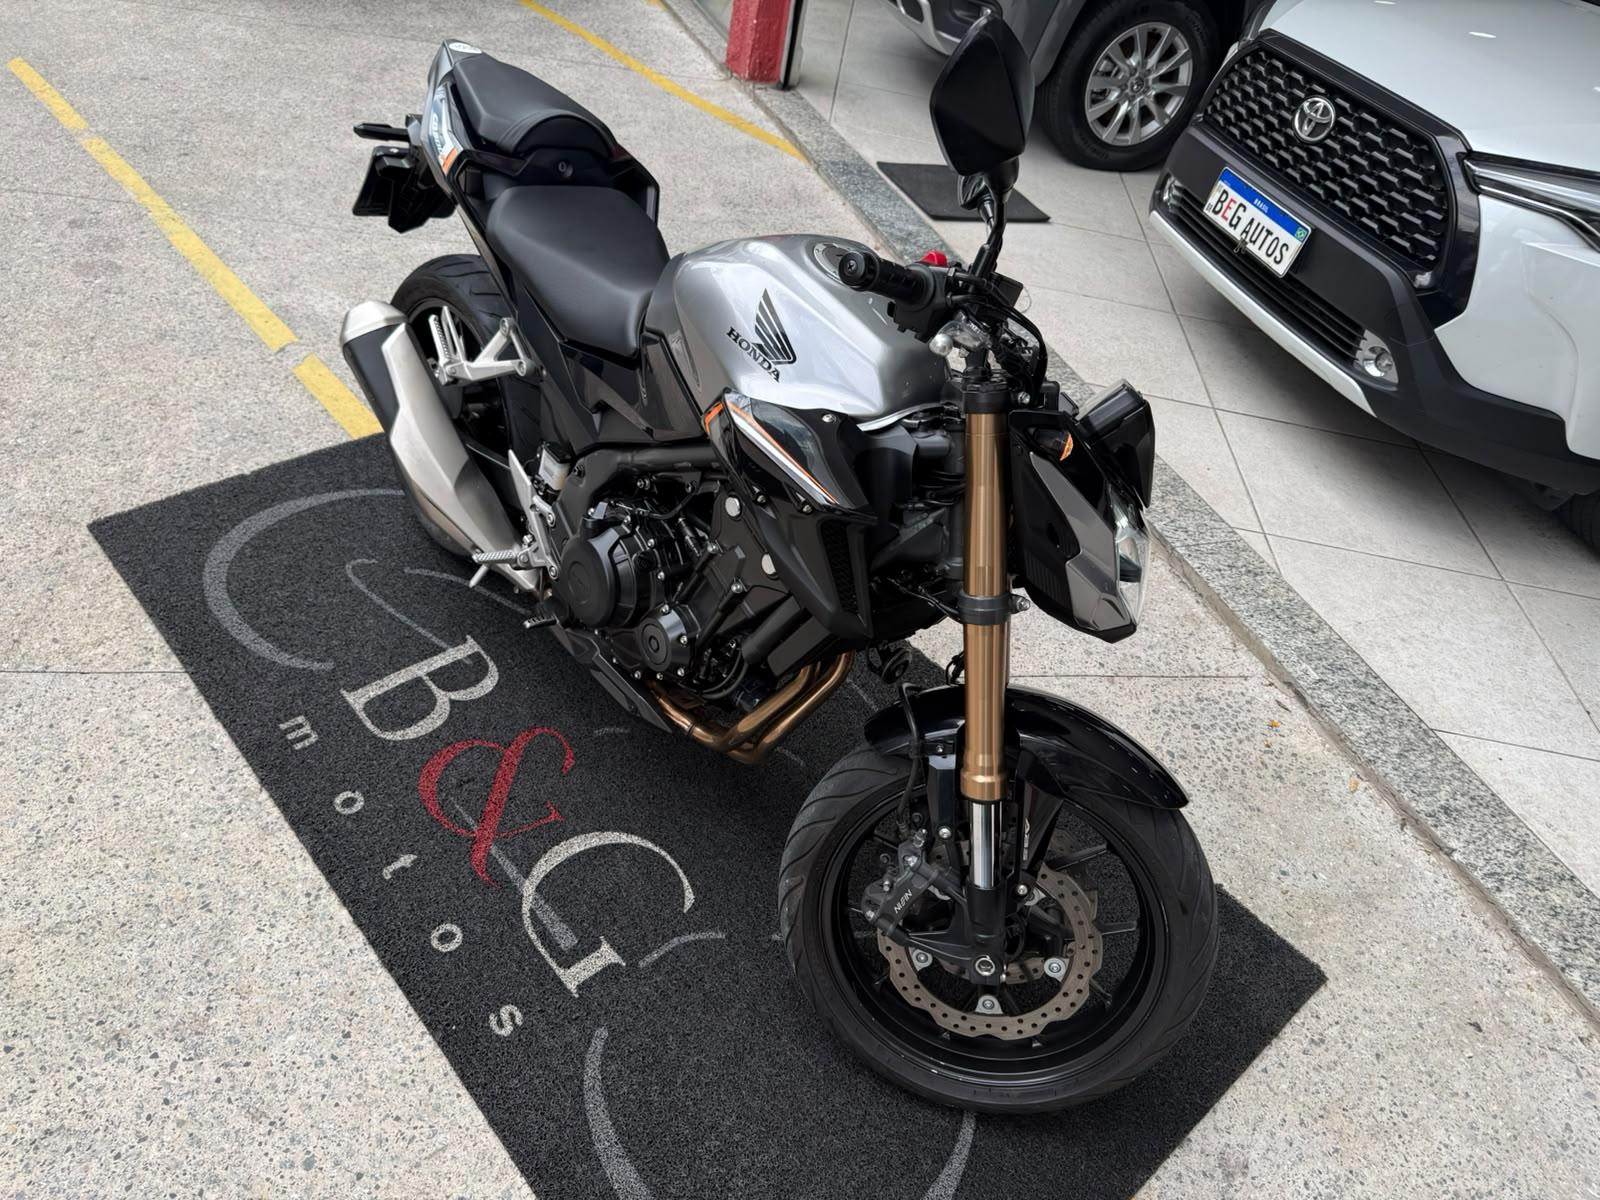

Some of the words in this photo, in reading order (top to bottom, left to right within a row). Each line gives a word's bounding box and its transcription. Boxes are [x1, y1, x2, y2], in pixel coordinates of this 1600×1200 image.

[1211, 189, 1247, 230] BEG
[1240, 217, 1289, 264] AUTOS
[726, 326, 780, 383] HONDA
